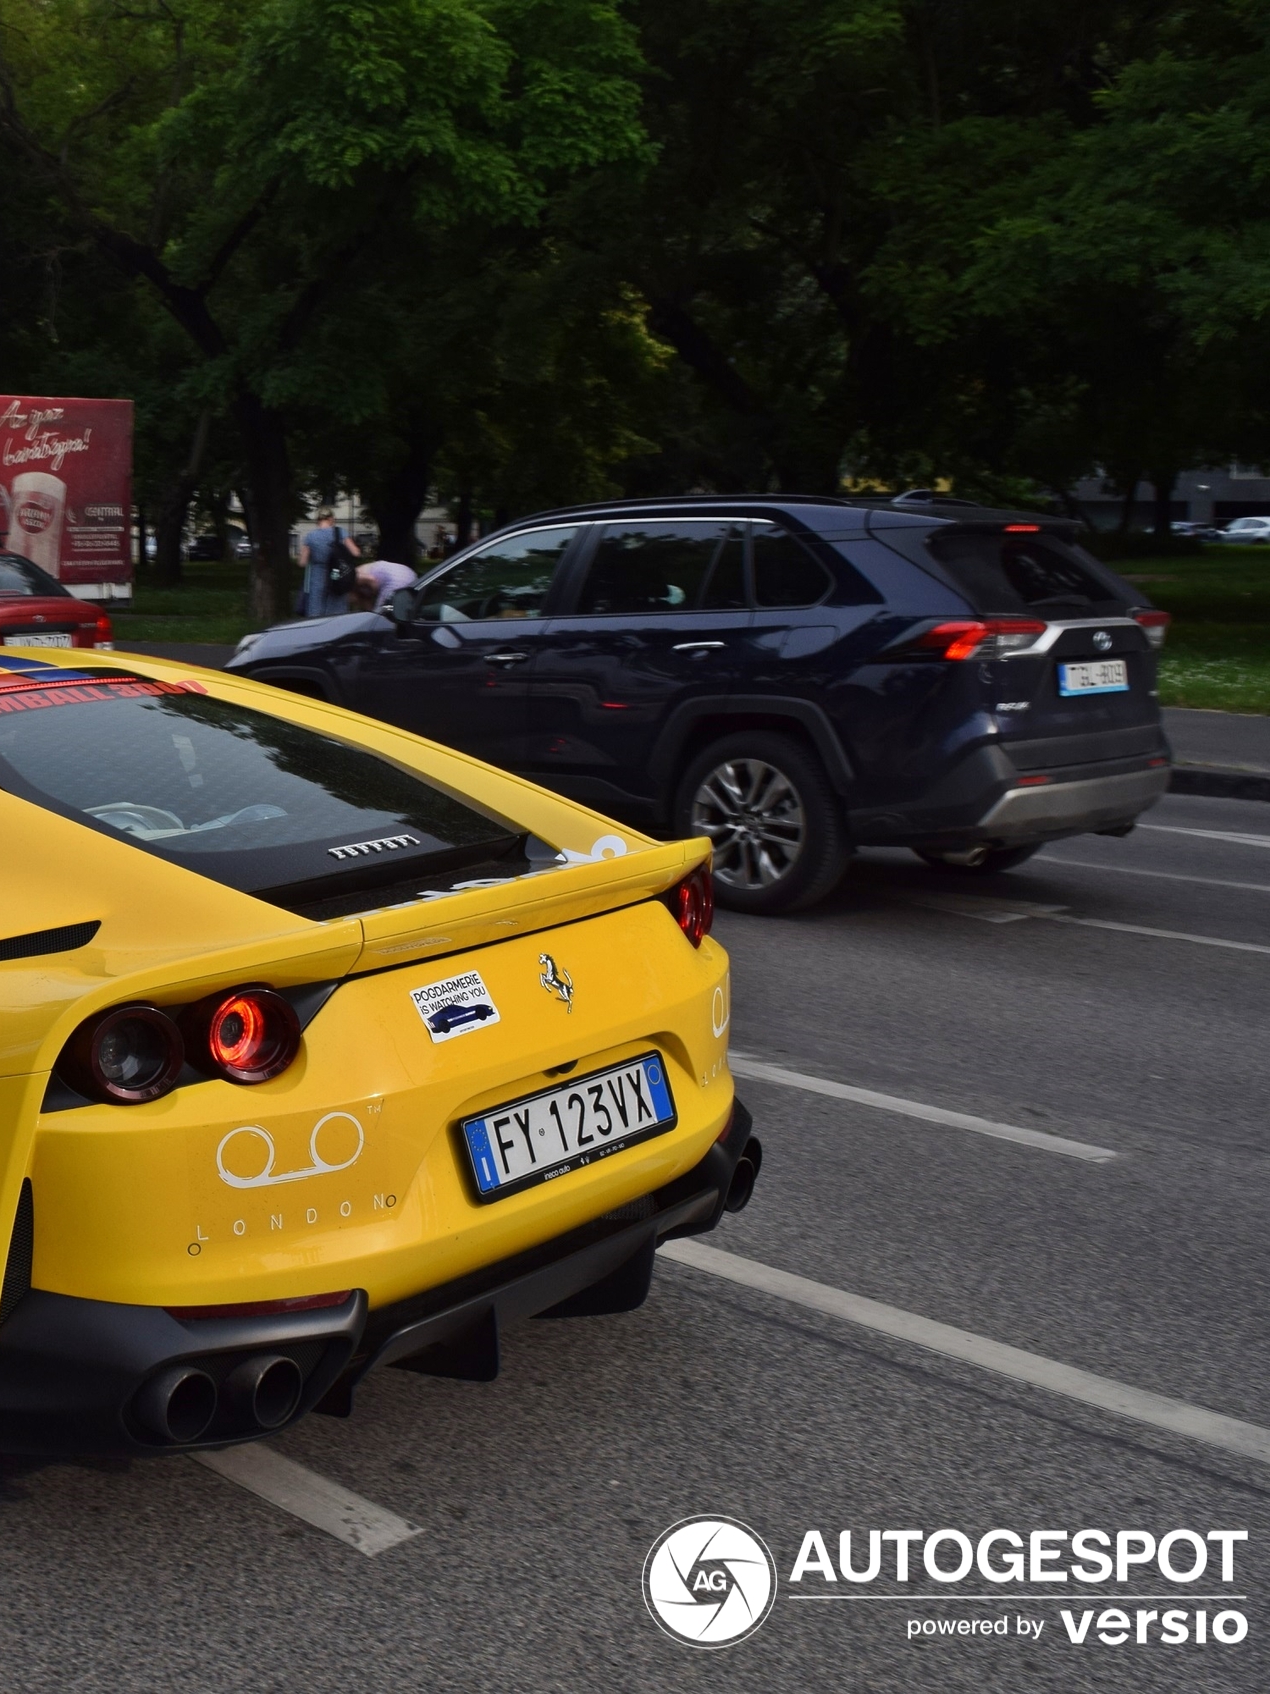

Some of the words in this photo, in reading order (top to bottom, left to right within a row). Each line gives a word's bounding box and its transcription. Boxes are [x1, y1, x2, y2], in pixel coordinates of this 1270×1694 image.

[113, 679, 209, 698] 3000
[468, 986, 486, 998] YOU
[492, 1108, 537, 1175] FY
[548, 1068, 653, 1153] 123VX
[196, 1193, 386, 1241] LONDON
